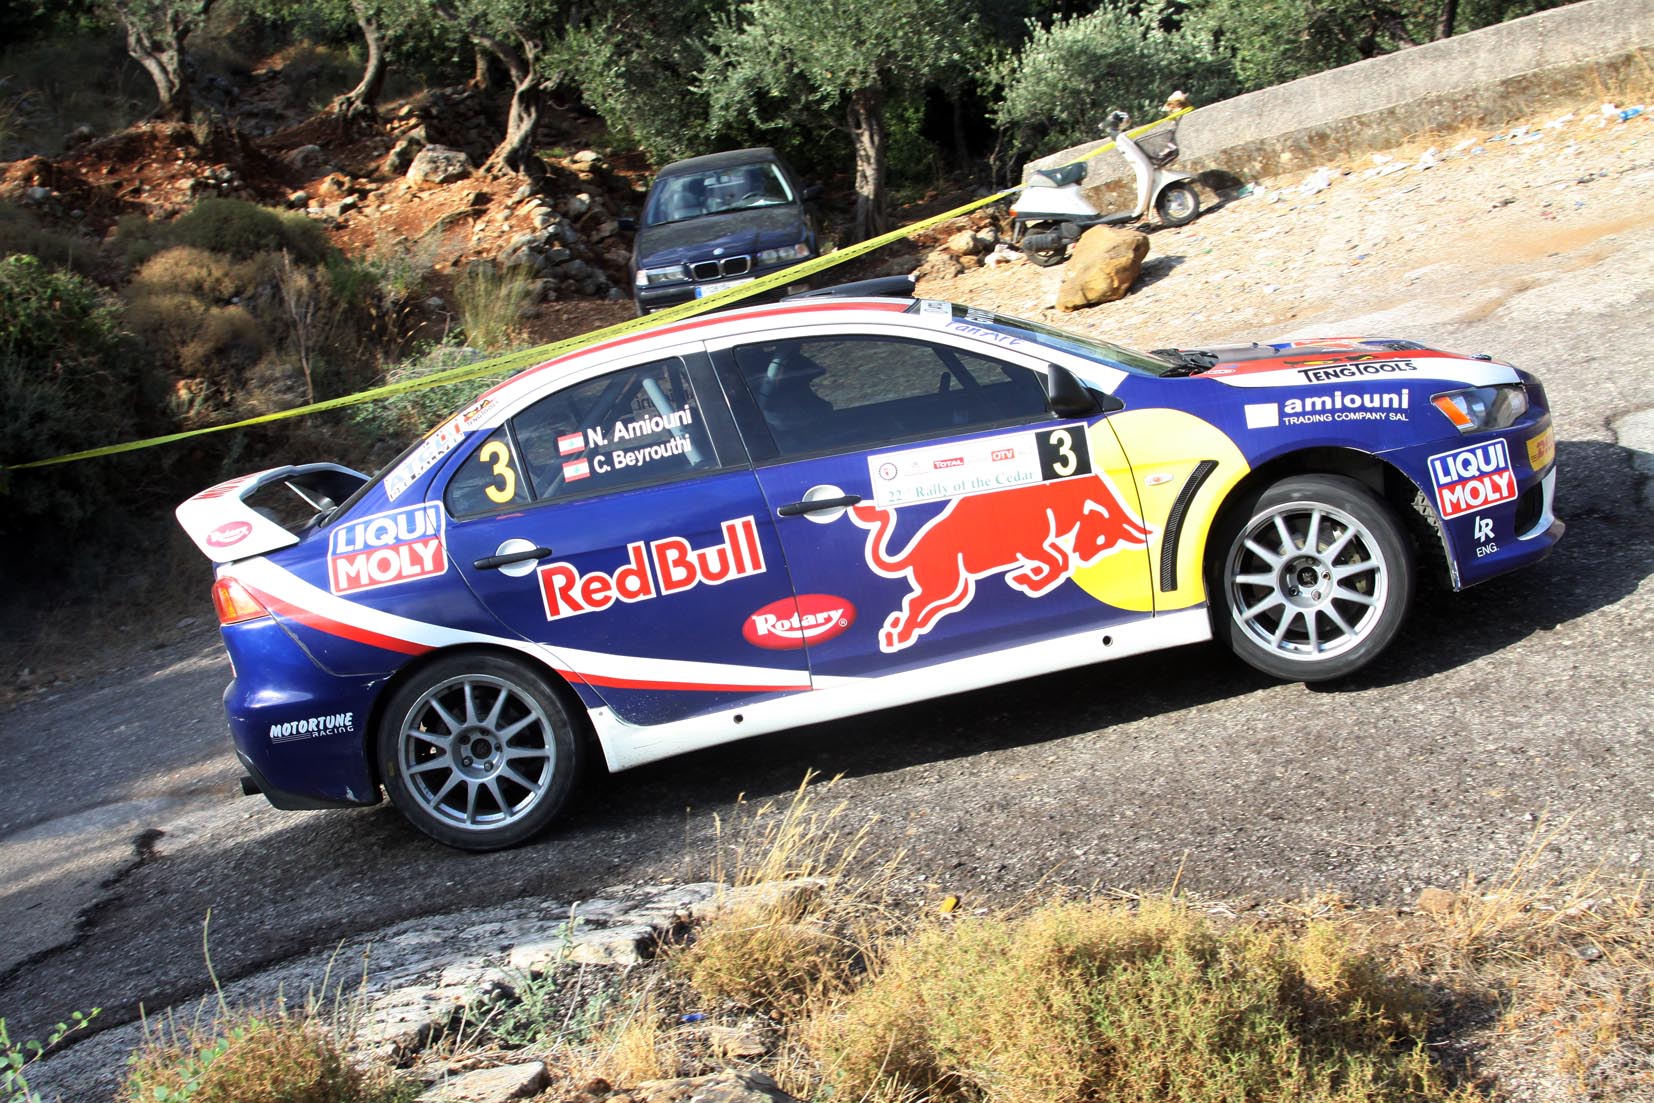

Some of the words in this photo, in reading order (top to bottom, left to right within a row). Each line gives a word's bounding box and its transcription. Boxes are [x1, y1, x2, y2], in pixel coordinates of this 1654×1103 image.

[1297, 358, 1419, 383] TENGTOOLS
[1283, 388, 1409, 414] amiouni
[587, 426, 609, 448] N.
[613, 404, 692, 442] Amiouni
[1283, 413, 1333, 426] TRADING
[1334, 411, 1387, 422] COMPANY
[1388, 412, 1409, 422] SAL
[593, 454, 611, 473] C.
[612, 433, 692, 469] Beyrouthi
[934, 458, 964, 469] TOTAL
[992, 449, 1014, 461] OTV
[1049, 428, 1077, 477] 3
[1433, 443, 1506, 485] LIQUI
[479, 440, 516, 503] 3
[915, 482, 951, 500] Rally
[953, 479, 968, 493] of
[971, 476, 994, 490] the
[995, 470, 1036, 486] Cedar
[1441, 471, 1510, 514] MOLY
[335, 506, 439, 554] LIQUI
[1476, 542, 1500, 557] ENG.
[335, 539, 439, 592] MOLY
[539, 543, 655, 619] Red
[652, 517, 764, 593] Bull
[751, 608, 844, 639] Rotary
[270, 712, 352, 737] MOTORTUNE
[312, 725, 354, 737] RACING
